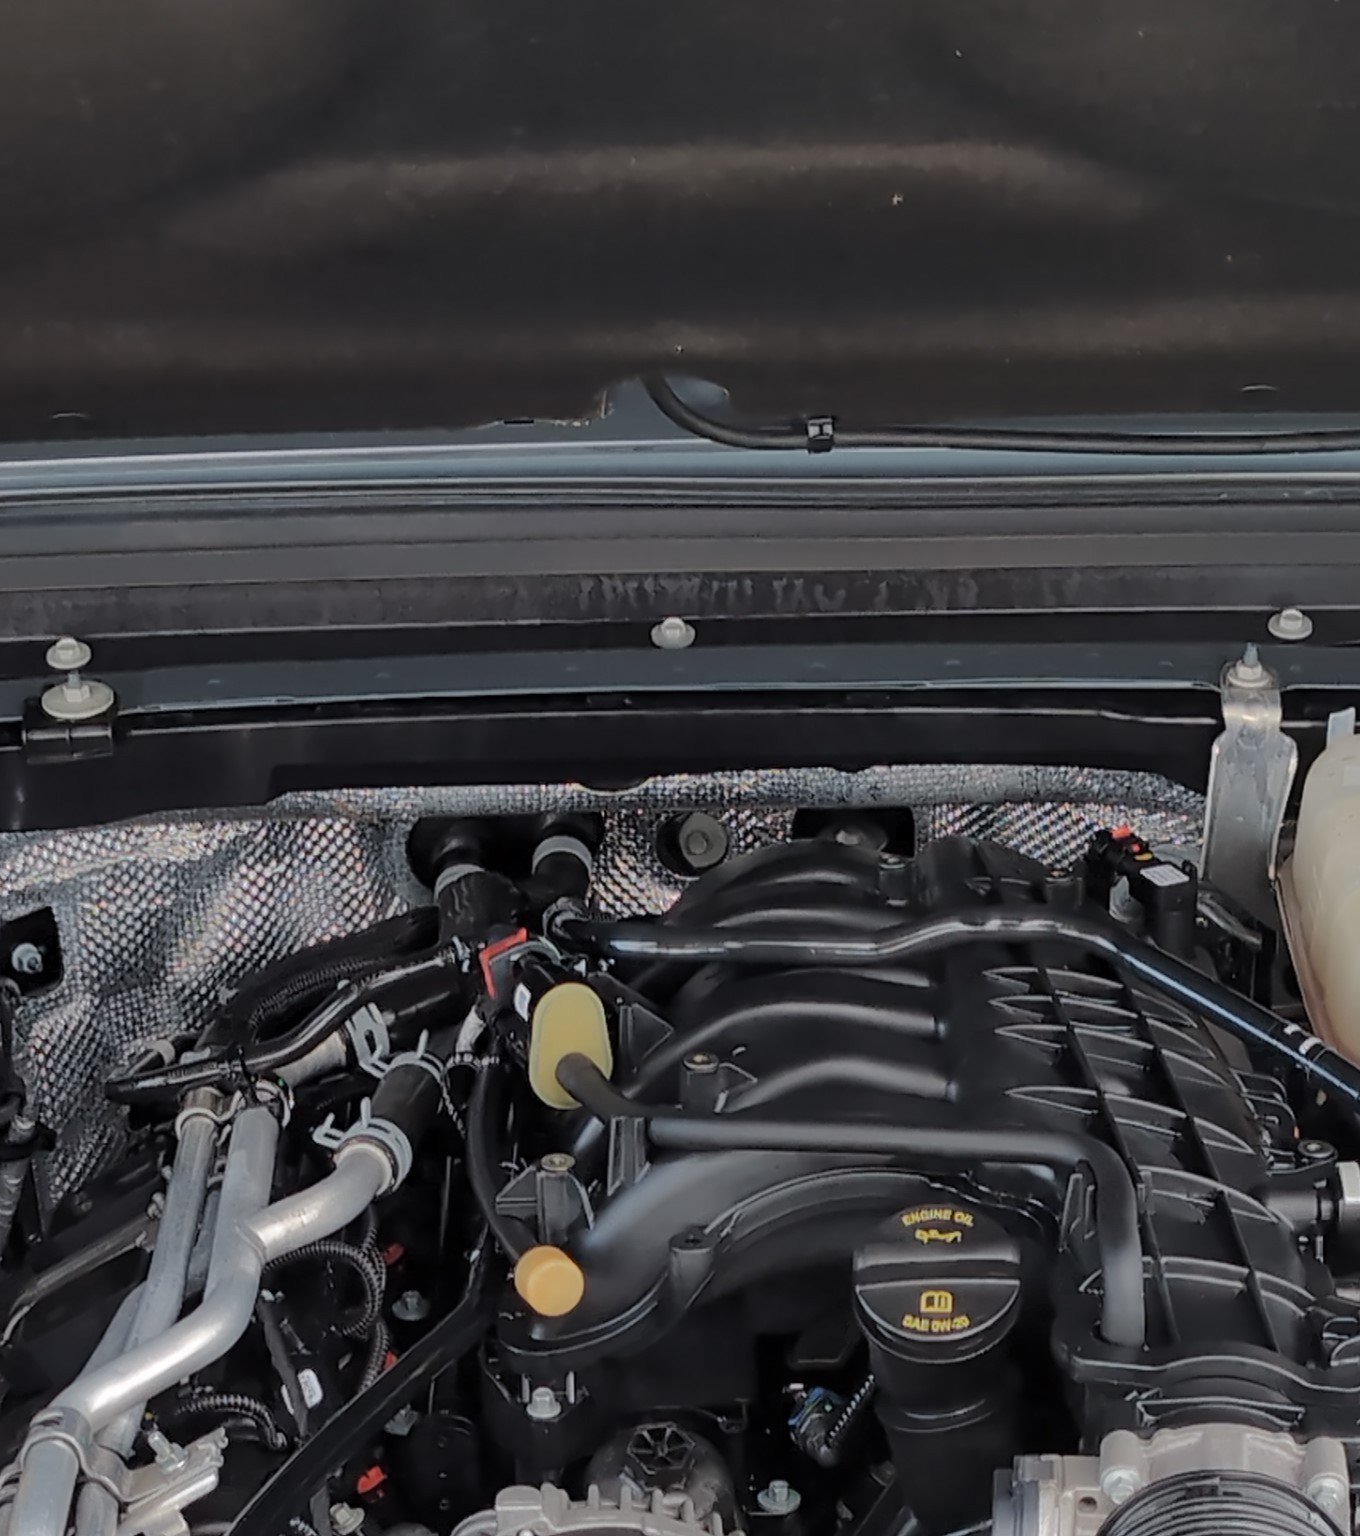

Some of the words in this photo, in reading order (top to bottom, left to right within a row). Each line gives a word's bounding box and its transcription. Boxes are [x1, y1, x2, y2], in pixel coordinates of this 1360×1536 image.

[902, 1208, 951, 1226] ENGINE
[953, 1211, 974, 1227] OIL
[902, 1314, 929, 1331] SAE
[931, 1314, 970, 1333] 0W-20
